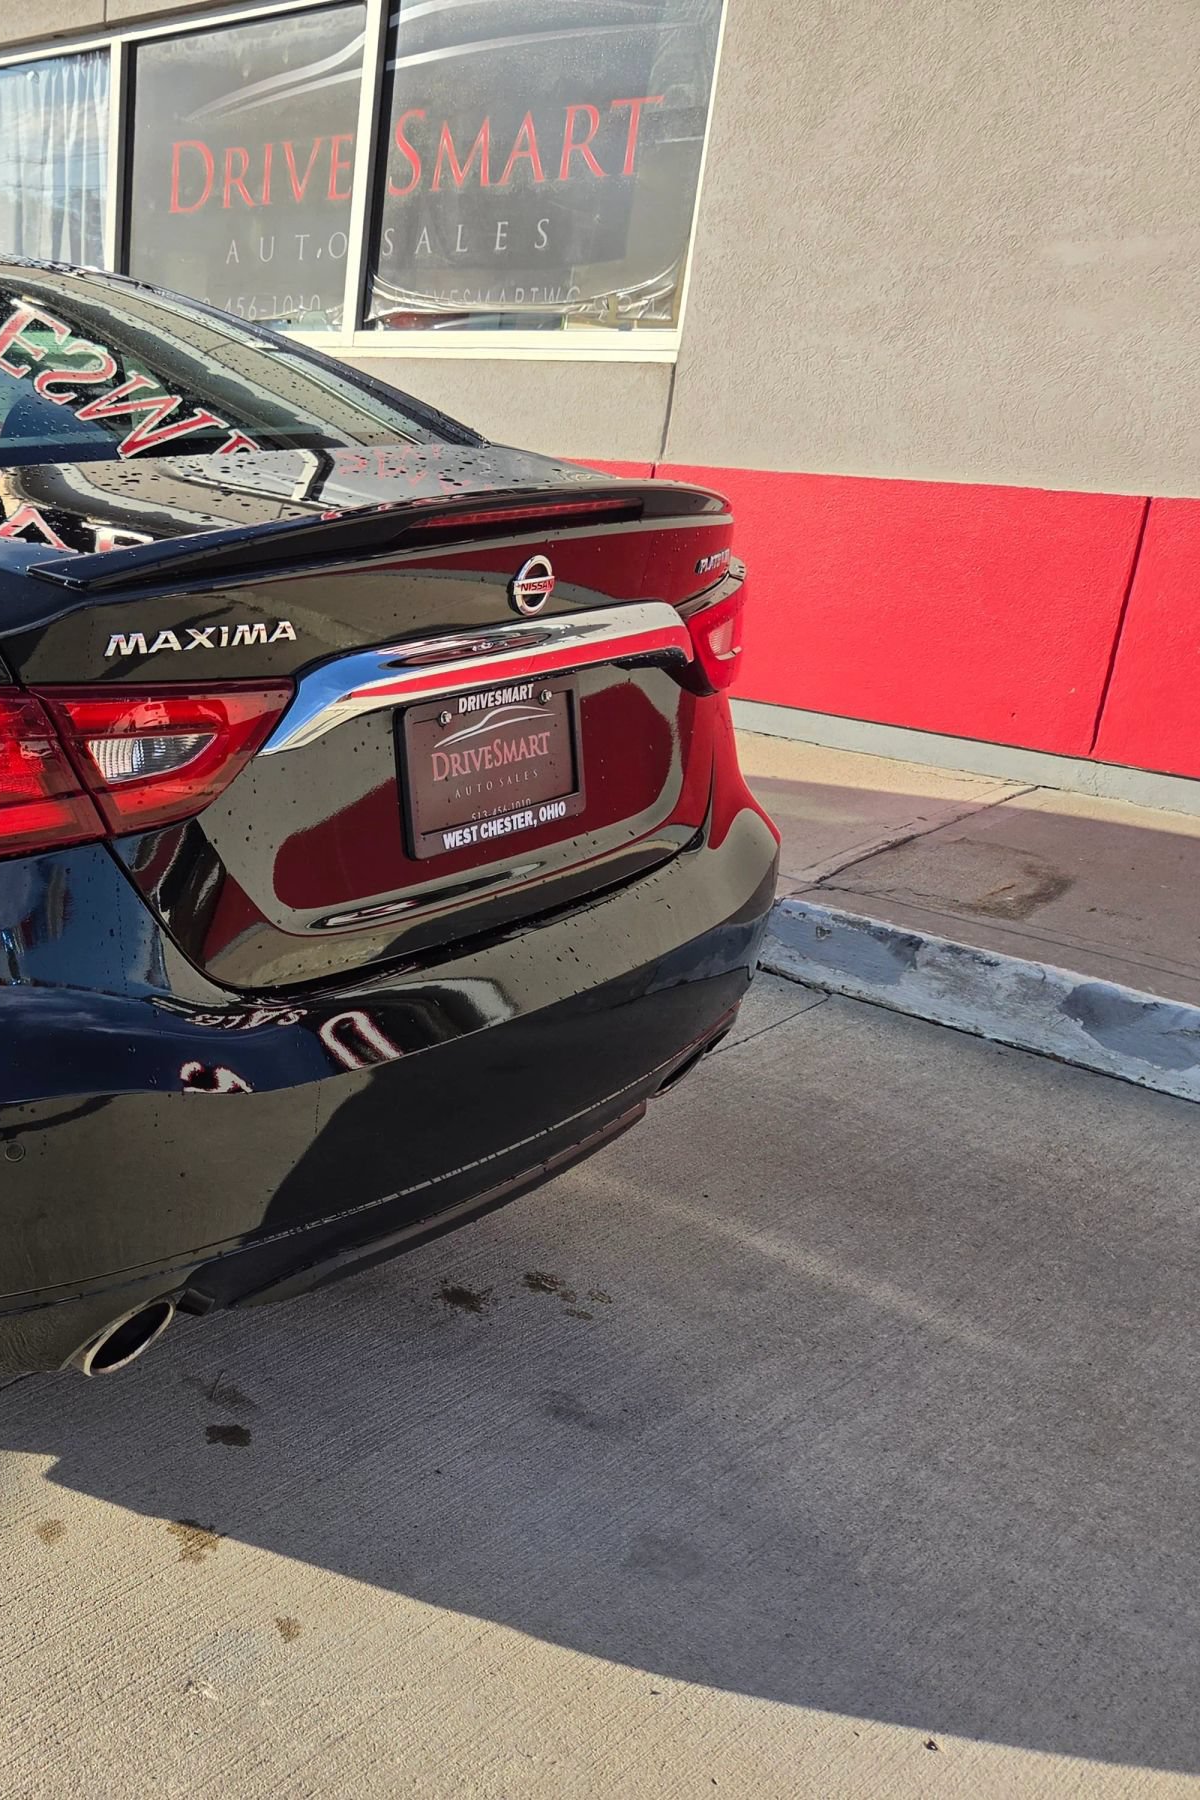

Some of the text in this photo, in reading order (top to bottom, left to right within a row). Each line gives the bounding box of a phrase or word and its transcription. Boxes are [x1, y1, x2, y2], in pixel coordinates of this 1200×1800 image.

[226, 218, 550, 265] AUTO SALES
[520, 580, 553, 592] NISSAN
[104, 620, 297, 657] MAXIMA
[458, 683, 535, 714] DRIVESMART
[455, 768, 538, 799] AUTO SALES
[443, 801, 567, 850] WEST CHESTER, OHIO
